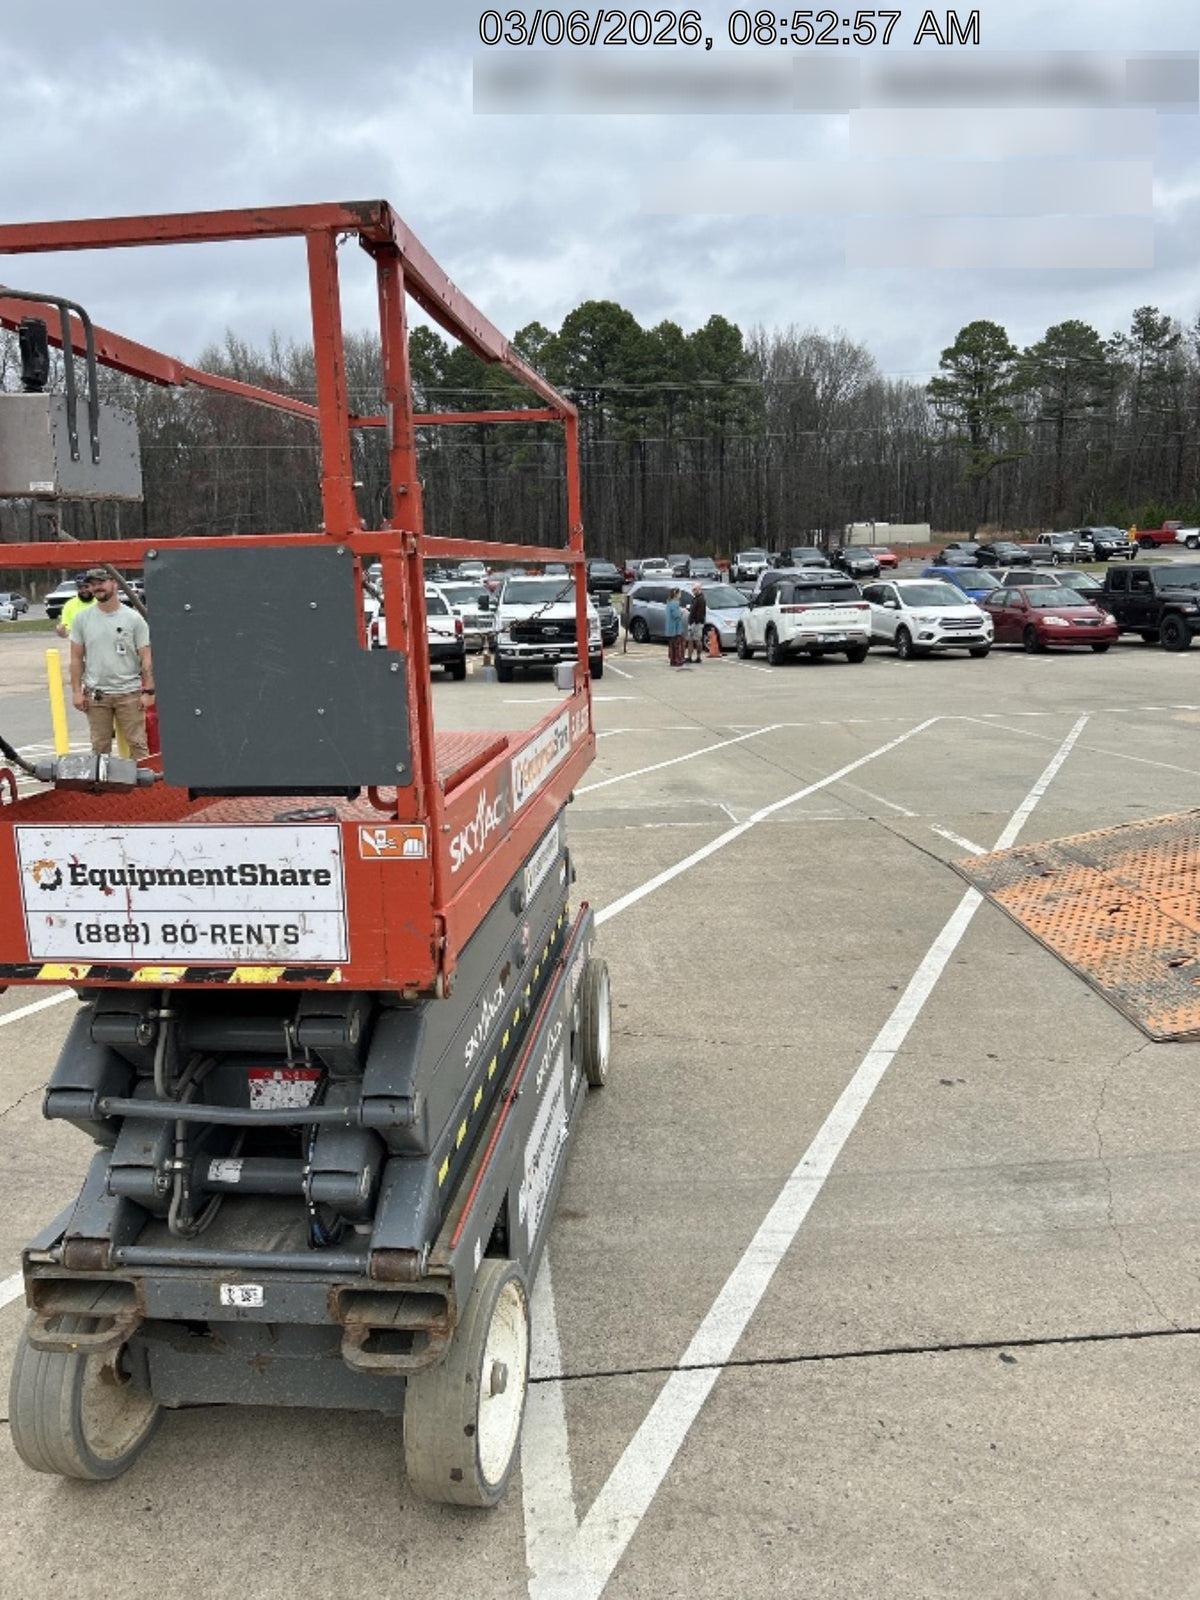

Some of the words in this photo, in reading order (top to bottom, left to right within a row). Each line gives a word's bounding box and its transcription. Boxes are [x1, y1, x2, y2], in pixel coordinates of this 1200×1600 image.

[449, 788, 510, 873] SKYJAC
[68, 863, 331, 891] EquipmentShare
[75, 922, 150, 946] (888)
[161, 921, 300, 947] 80-RENTS
